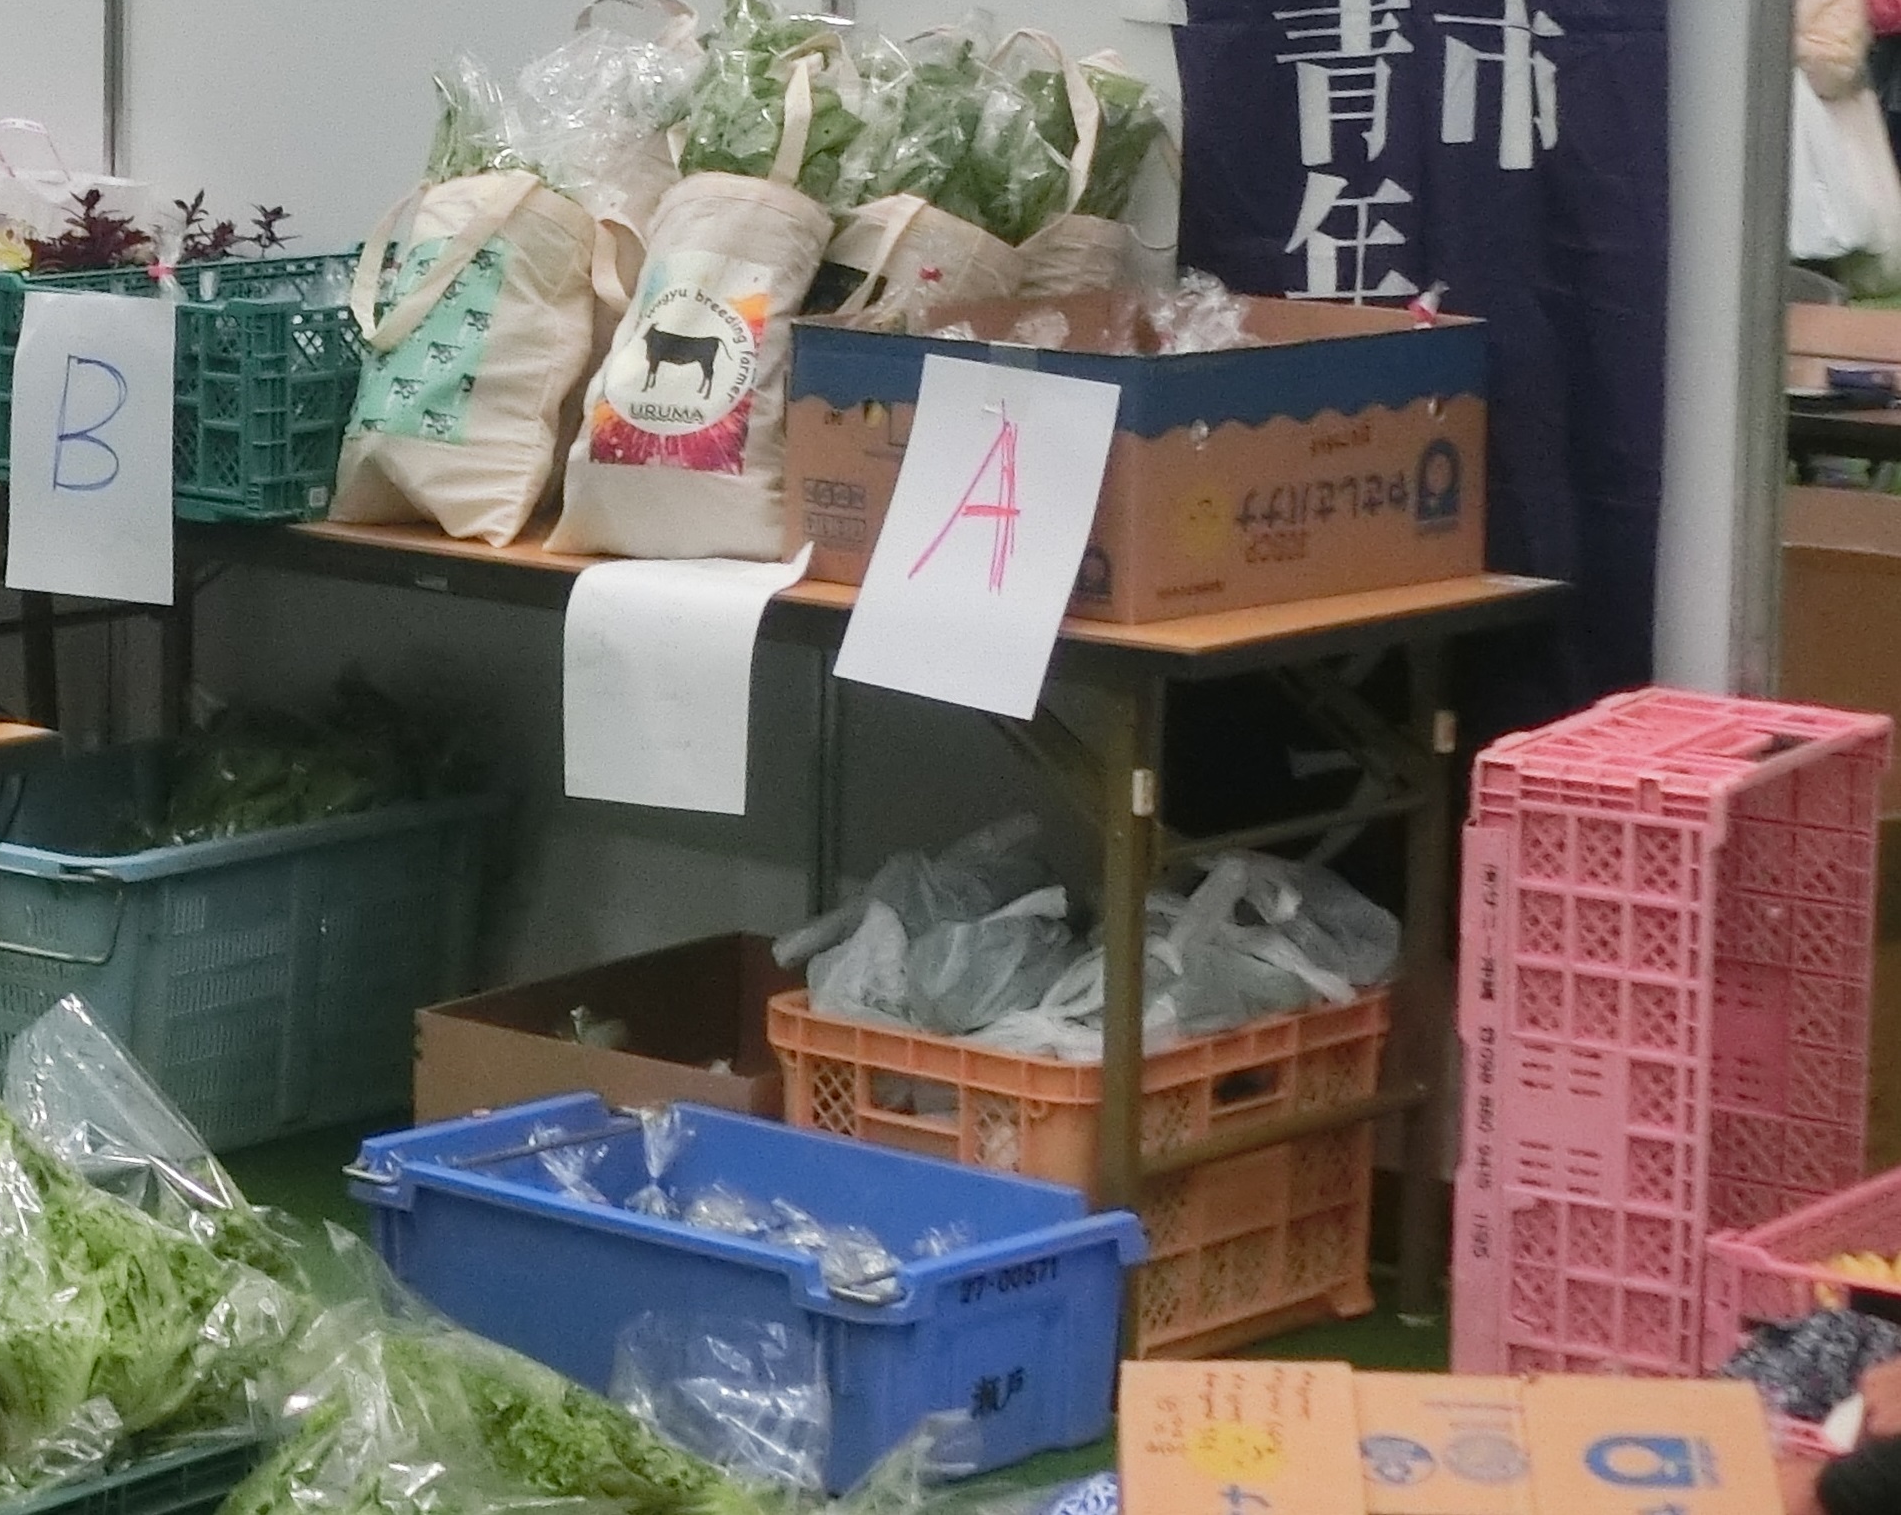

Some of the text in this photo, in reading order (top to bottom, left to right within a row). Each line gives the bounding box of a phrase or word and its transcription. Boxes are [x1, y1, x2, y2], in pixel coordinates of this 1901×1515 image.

[695, 289, 749, 344] breeding
[726, 349, 760, 403] farmer
[52, 353, 128, 491] B
[629, 403, 704, 425] URUMA
[907, 397, 1021, 597] A
